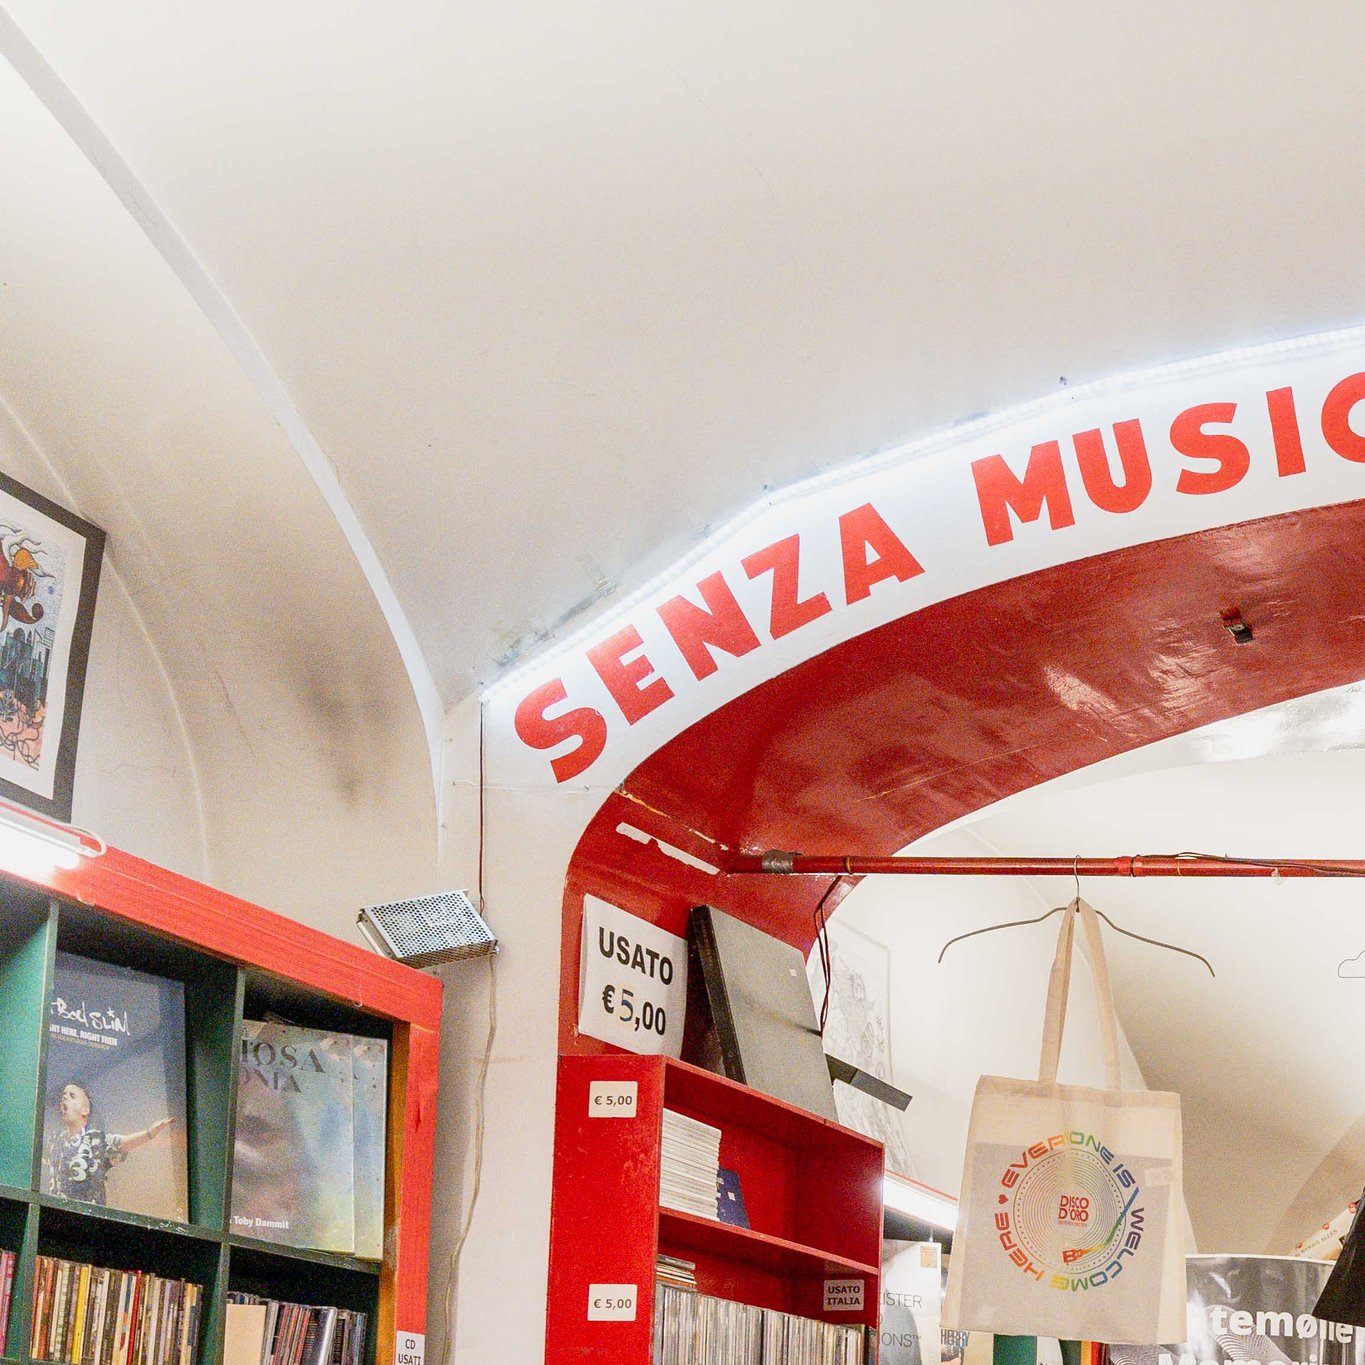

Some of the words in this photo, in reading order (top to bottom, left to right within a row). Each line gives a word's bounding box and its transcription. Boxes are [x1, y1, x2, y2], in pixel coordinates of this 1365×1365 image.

[513, 502, 925, 784] SENZA
[598, 926, 674, 986] USATO
[606, 1094, 633, 1107] 5,00
[1060, 1195, 1089, 1209] DISCO
[234, 1215, 254, 1232] Toby
[255, 1218, 290, 1230] Dammit
[827, 1285, 860, 1296] USATO
[605, 1298, 632, 1310] 5,00
[826, 1295, 861, 1307] ITALIA
[404, 1338, 416, 1351] CD
